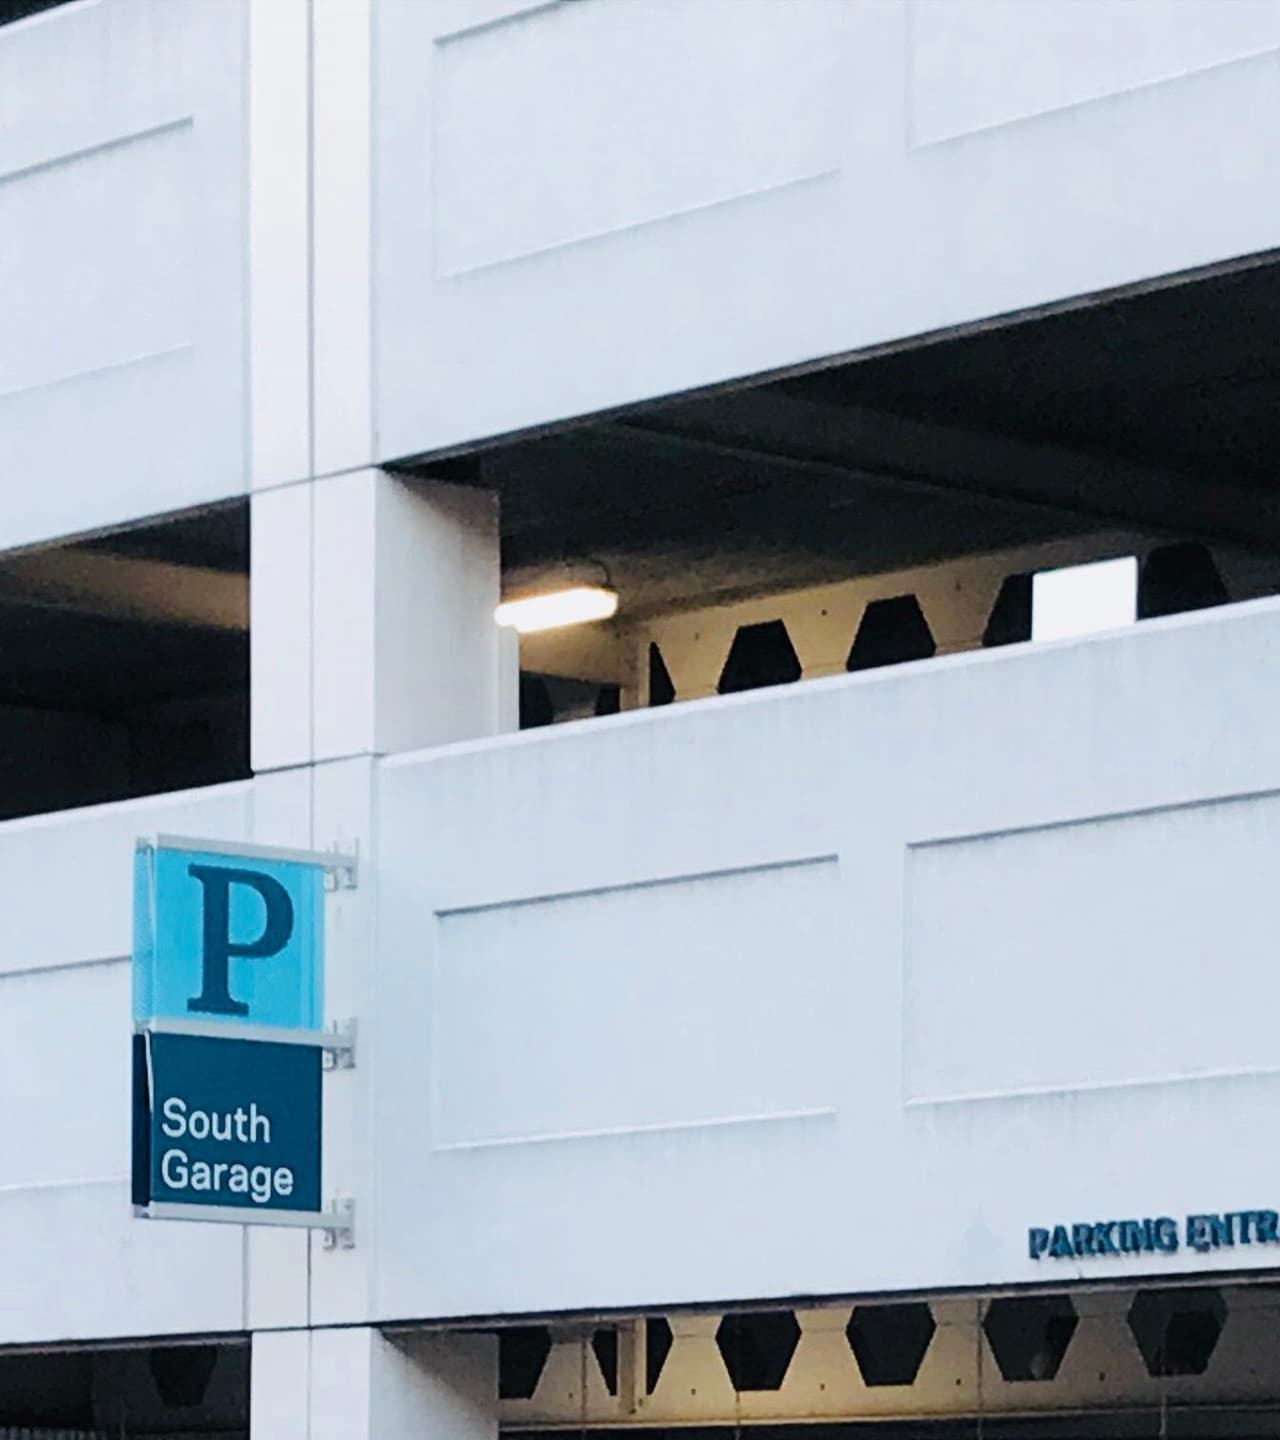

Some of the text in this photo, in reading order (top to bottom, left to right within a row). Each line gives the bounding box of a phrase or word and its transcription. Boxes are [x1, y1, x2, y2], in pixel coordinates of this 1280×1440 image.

[187, 863, 294, 1016] P
[161, 1097, 271, 1143] South
[161, 1149, 294, 1203] Garage
[1028, 1217, 1179, 1260] PARKING
